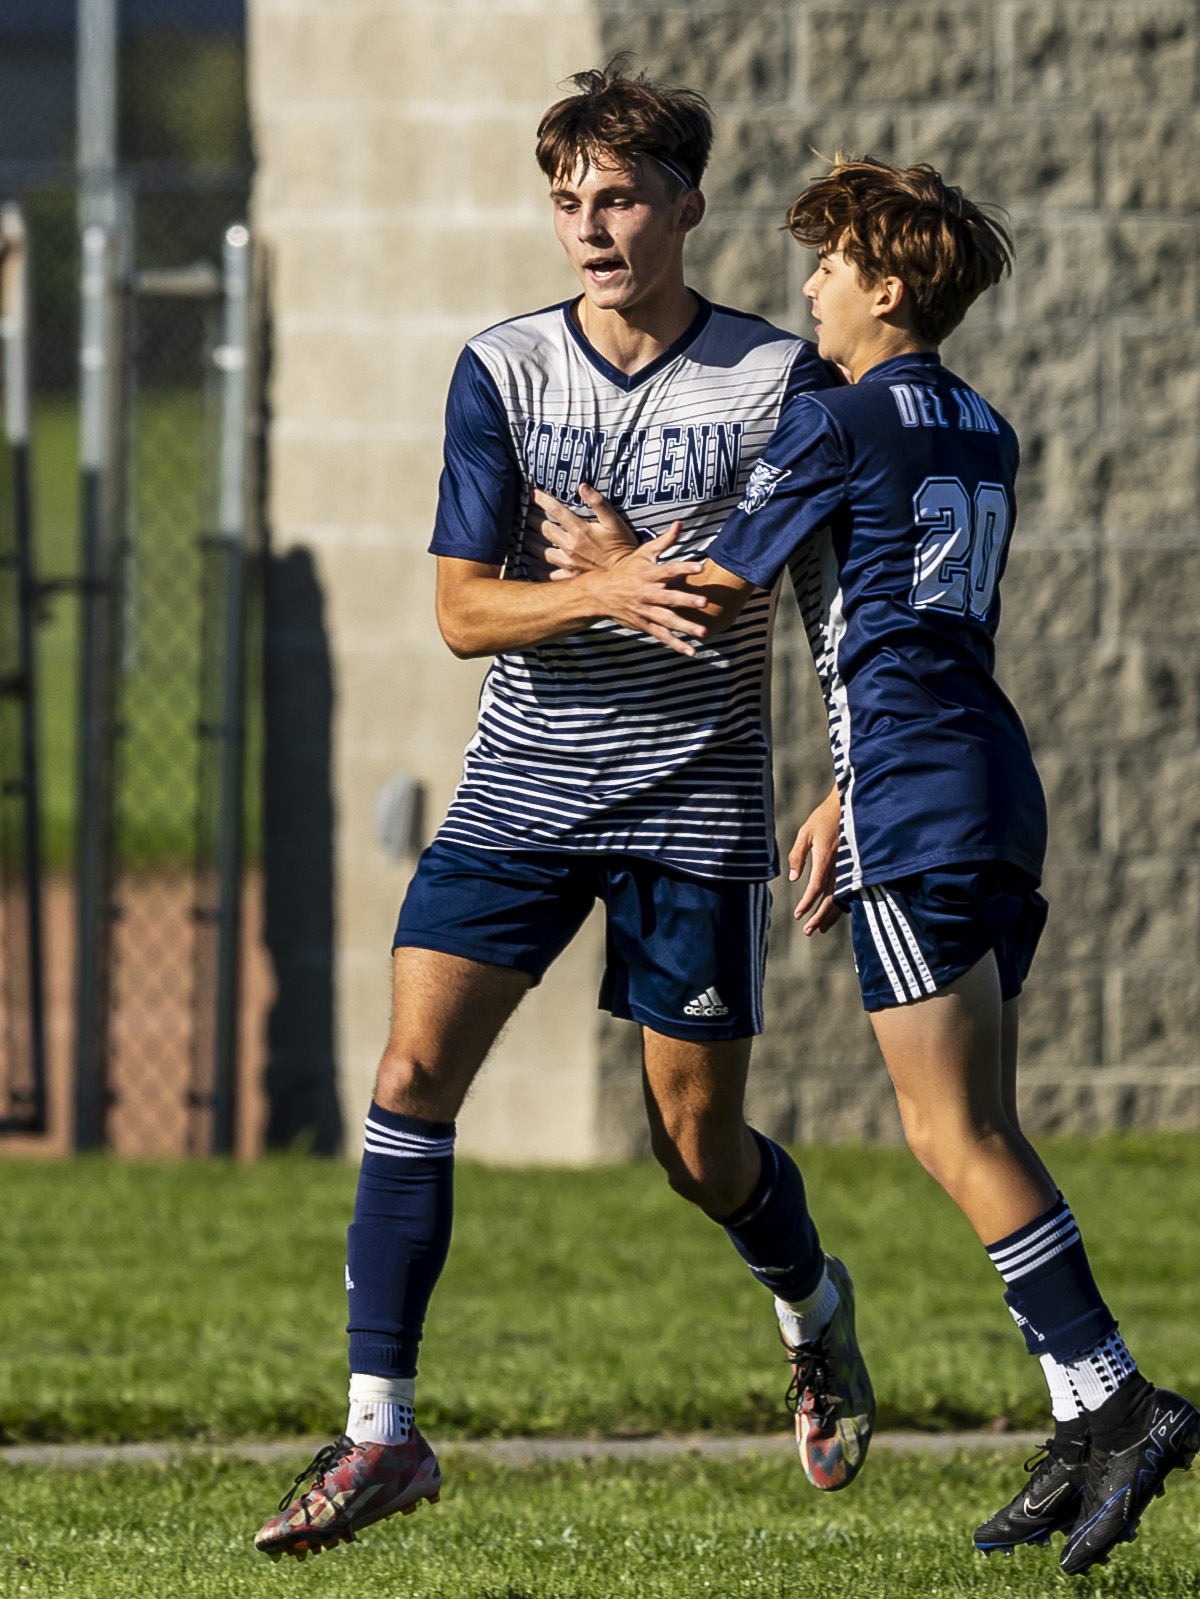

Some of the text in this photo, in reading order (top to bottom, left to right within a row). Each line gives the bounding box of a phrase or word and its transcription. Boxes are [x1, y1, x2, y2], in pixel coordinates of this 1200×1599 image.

[889, 383, 949, 428] DEL
[607, 421, 745, 508] GLENN
[908, 476, 1009, 622] 20
